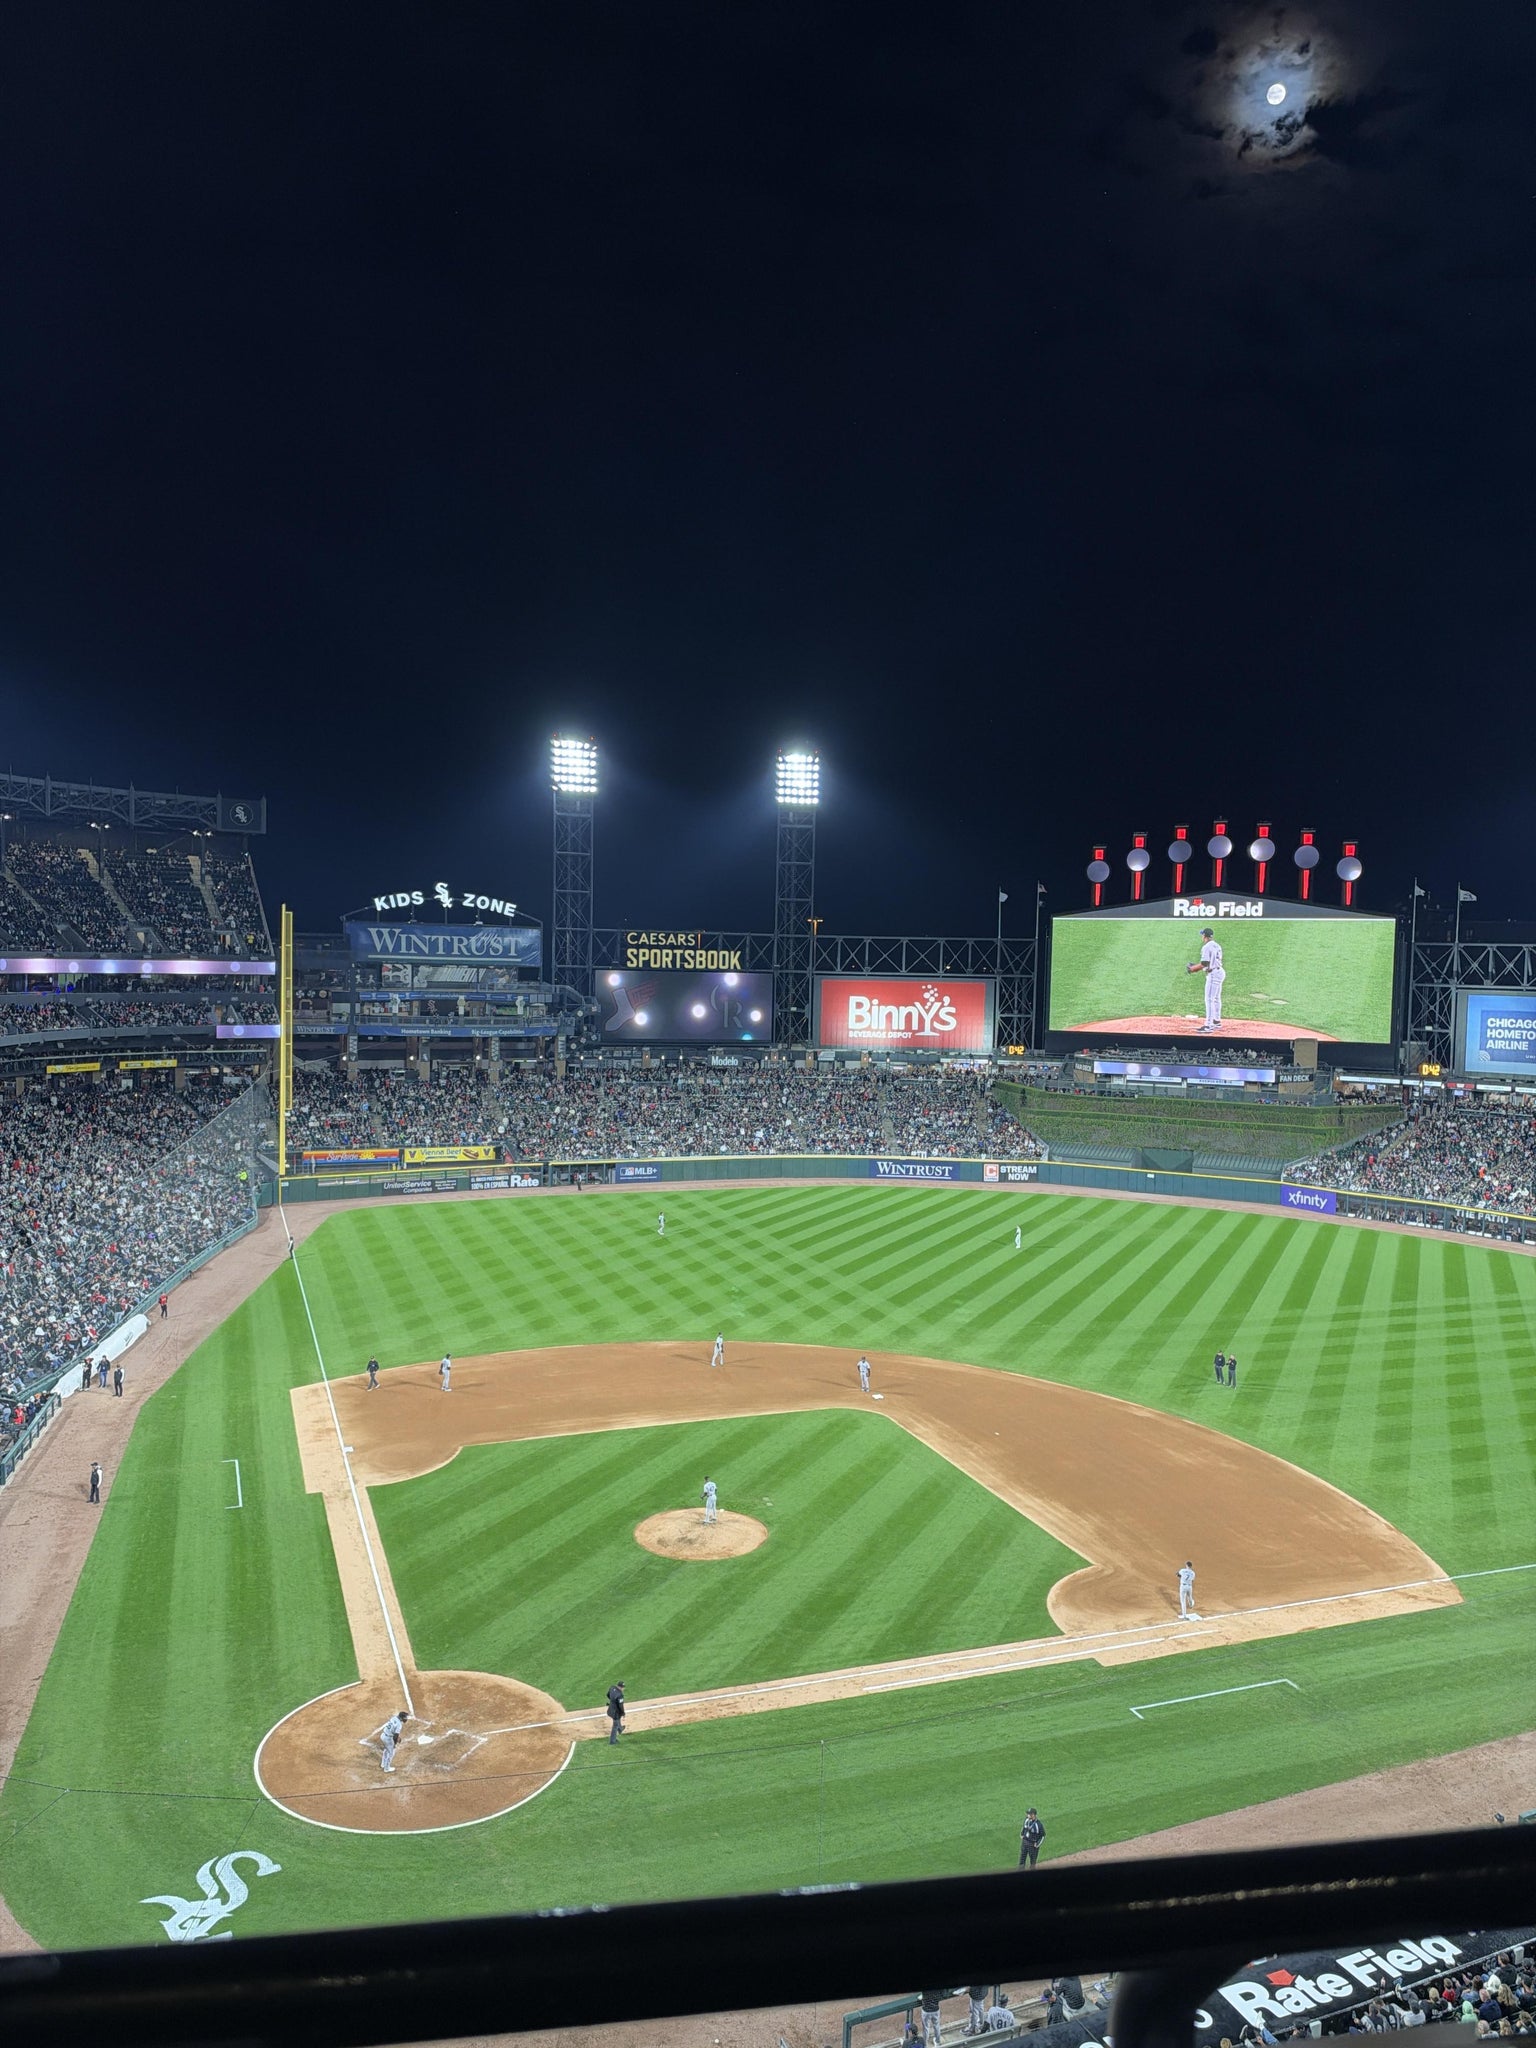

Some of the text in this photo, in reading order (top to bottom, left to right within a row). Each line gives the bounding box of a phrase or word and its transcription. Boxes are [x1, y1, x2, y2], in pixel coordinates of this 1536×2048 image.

[374, 891, 424, 912] KIDS
[462, 893, 517, 917] ZONE
[1174, 898, 1263, 916] Rate Field
[368, 928, 521, 957] WINTRUST
[627, 932, 695, 945] CAESARS
[627, 948, 742, 970] SPORTSBOOK
[848, 1030, 886, 1038] BEVERAGE
[1486, 1028, 1536, 1040] HOMETO
[1486, 1040, 1528, 1050] AIRLINE
[711, 1055, 739, 1066] Modelo
[1293, 1074, 1309, 1082] DECK
[877, 1161, 953, 1177] WINTRUST
[1000, 1166, 1037, 1174] STREAM
[510, 1175, 539, 1187] Rate
[1288, 1190, 1327, 1209] xfinity
[1217, 1973, 1353, 2028] Rate
[997, 2019, 1007, 2029] 81
